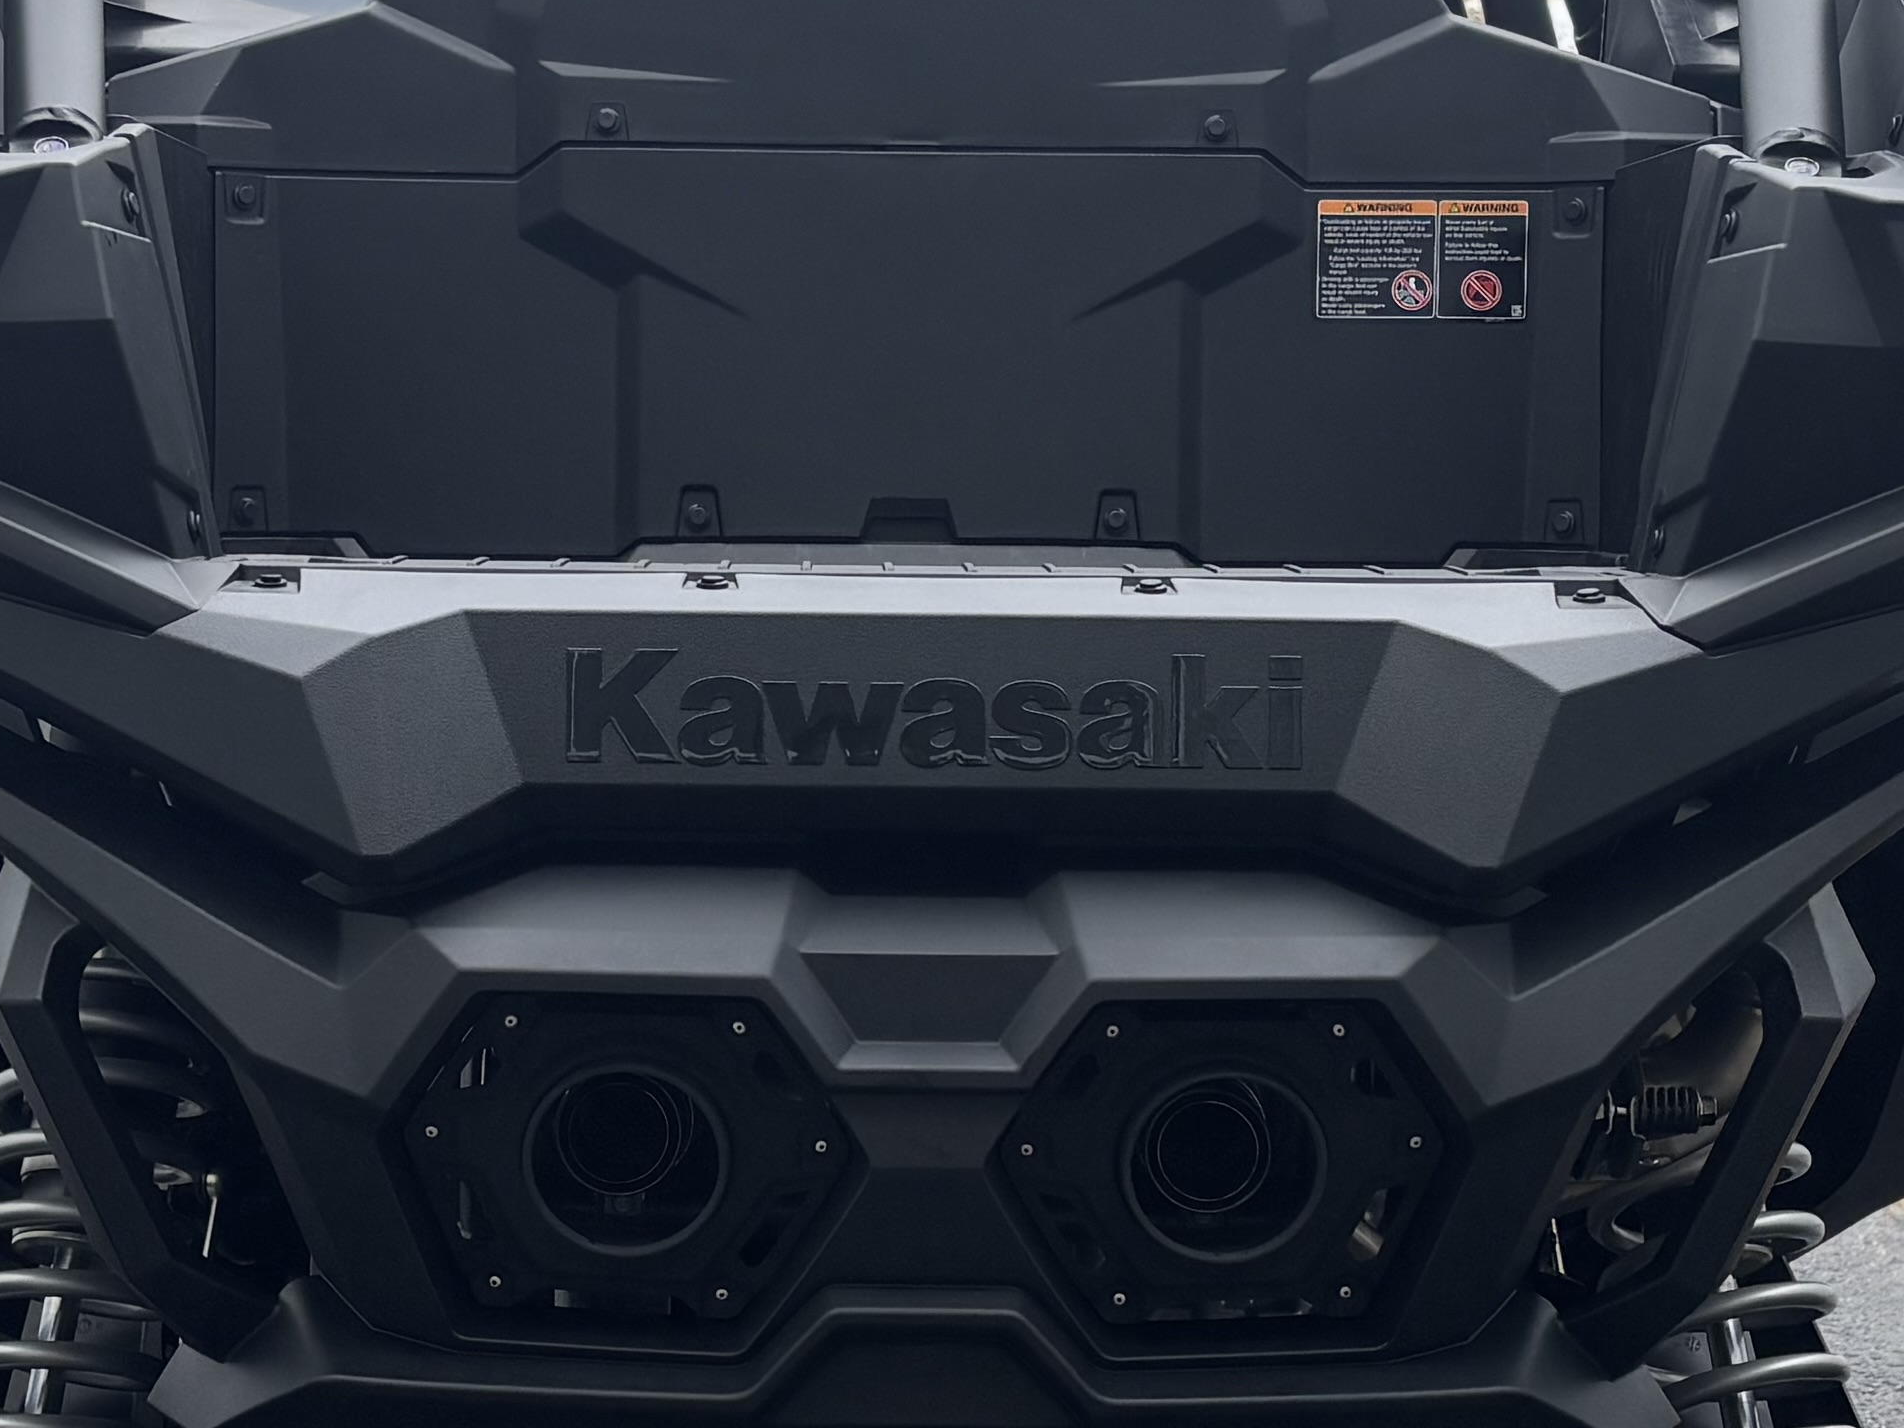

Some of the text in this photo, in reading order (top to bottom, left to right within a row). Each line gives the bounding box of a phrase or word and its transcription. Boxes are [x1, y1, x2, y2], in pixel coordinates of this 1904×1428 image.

[1357, 203, 1413, 212] WARNING
[1463, 203, 1519, 213] WARNING
[564, 646, 1304, 770] Kawasaki
